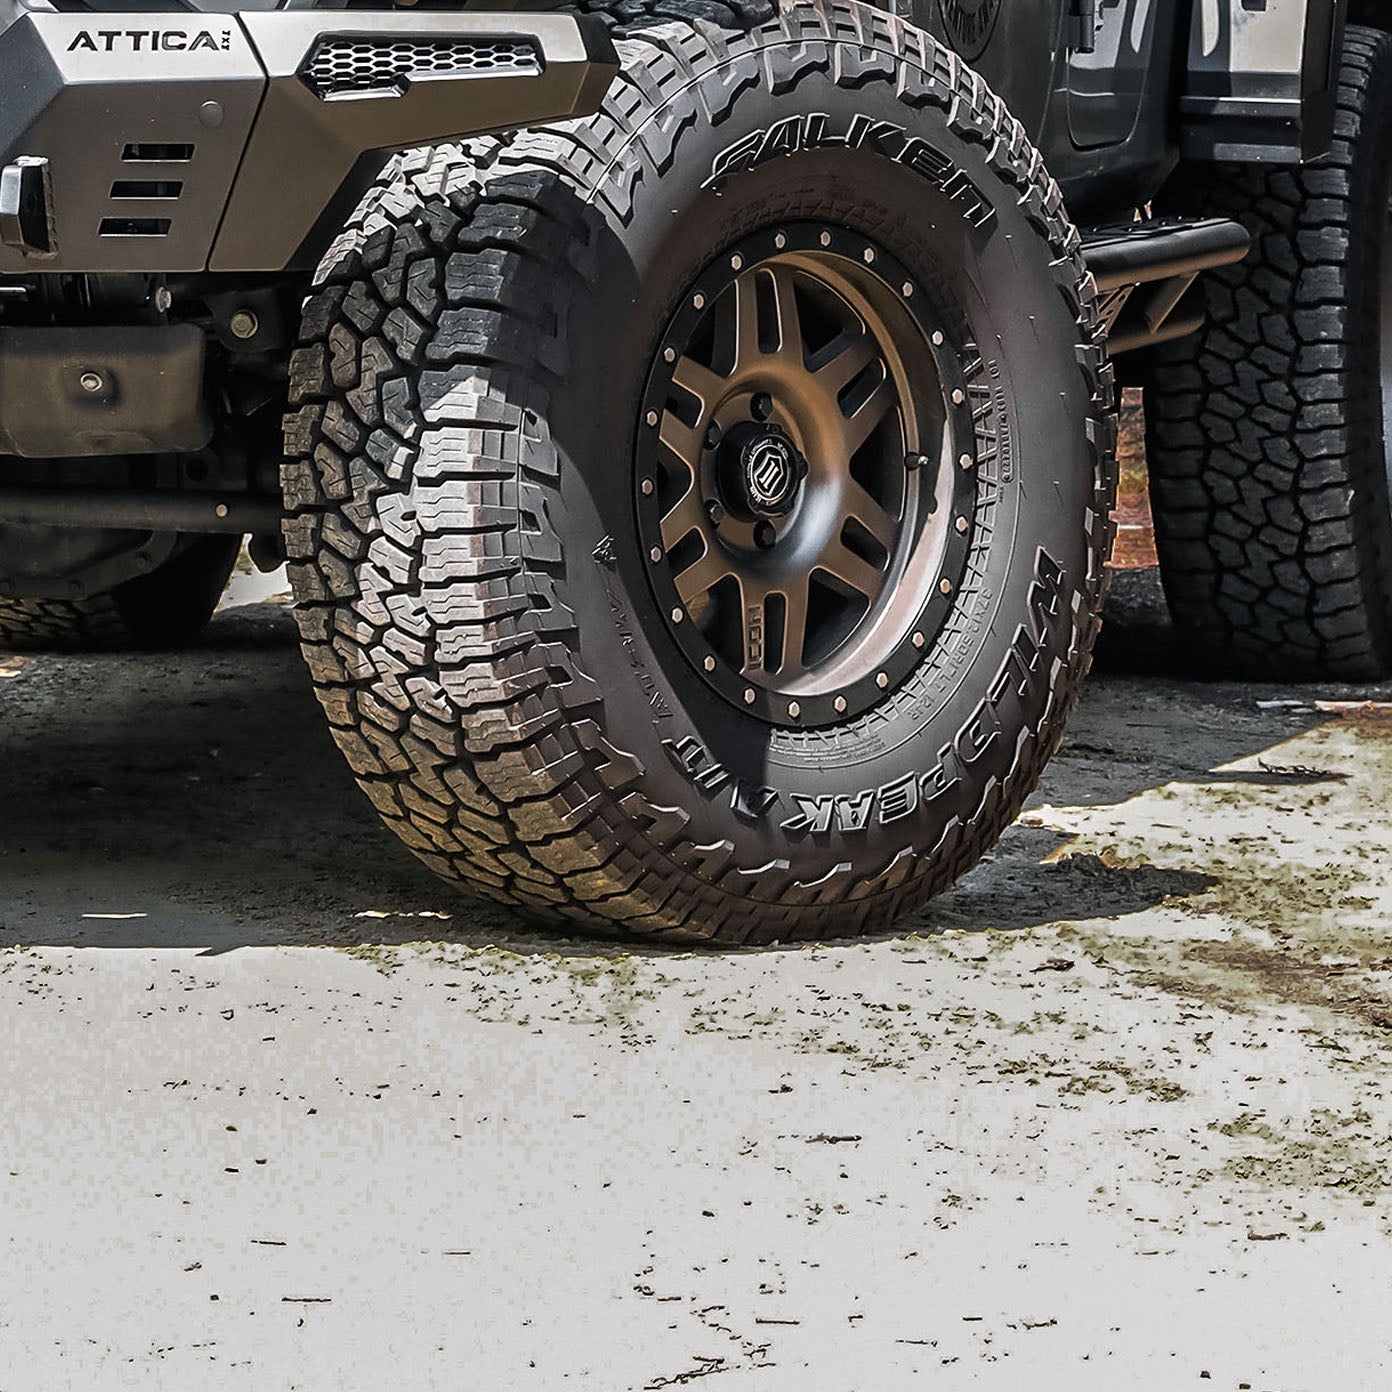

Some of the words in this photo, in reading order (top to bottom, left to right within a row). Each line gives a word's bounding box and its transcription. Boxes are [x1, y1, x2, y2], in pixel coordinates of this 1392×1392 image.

[66, 30, 219, 52] ATTICA
[700, 112, 996, 228] FALKEN
[779, 545, 1068, 833] WILDPEAK
